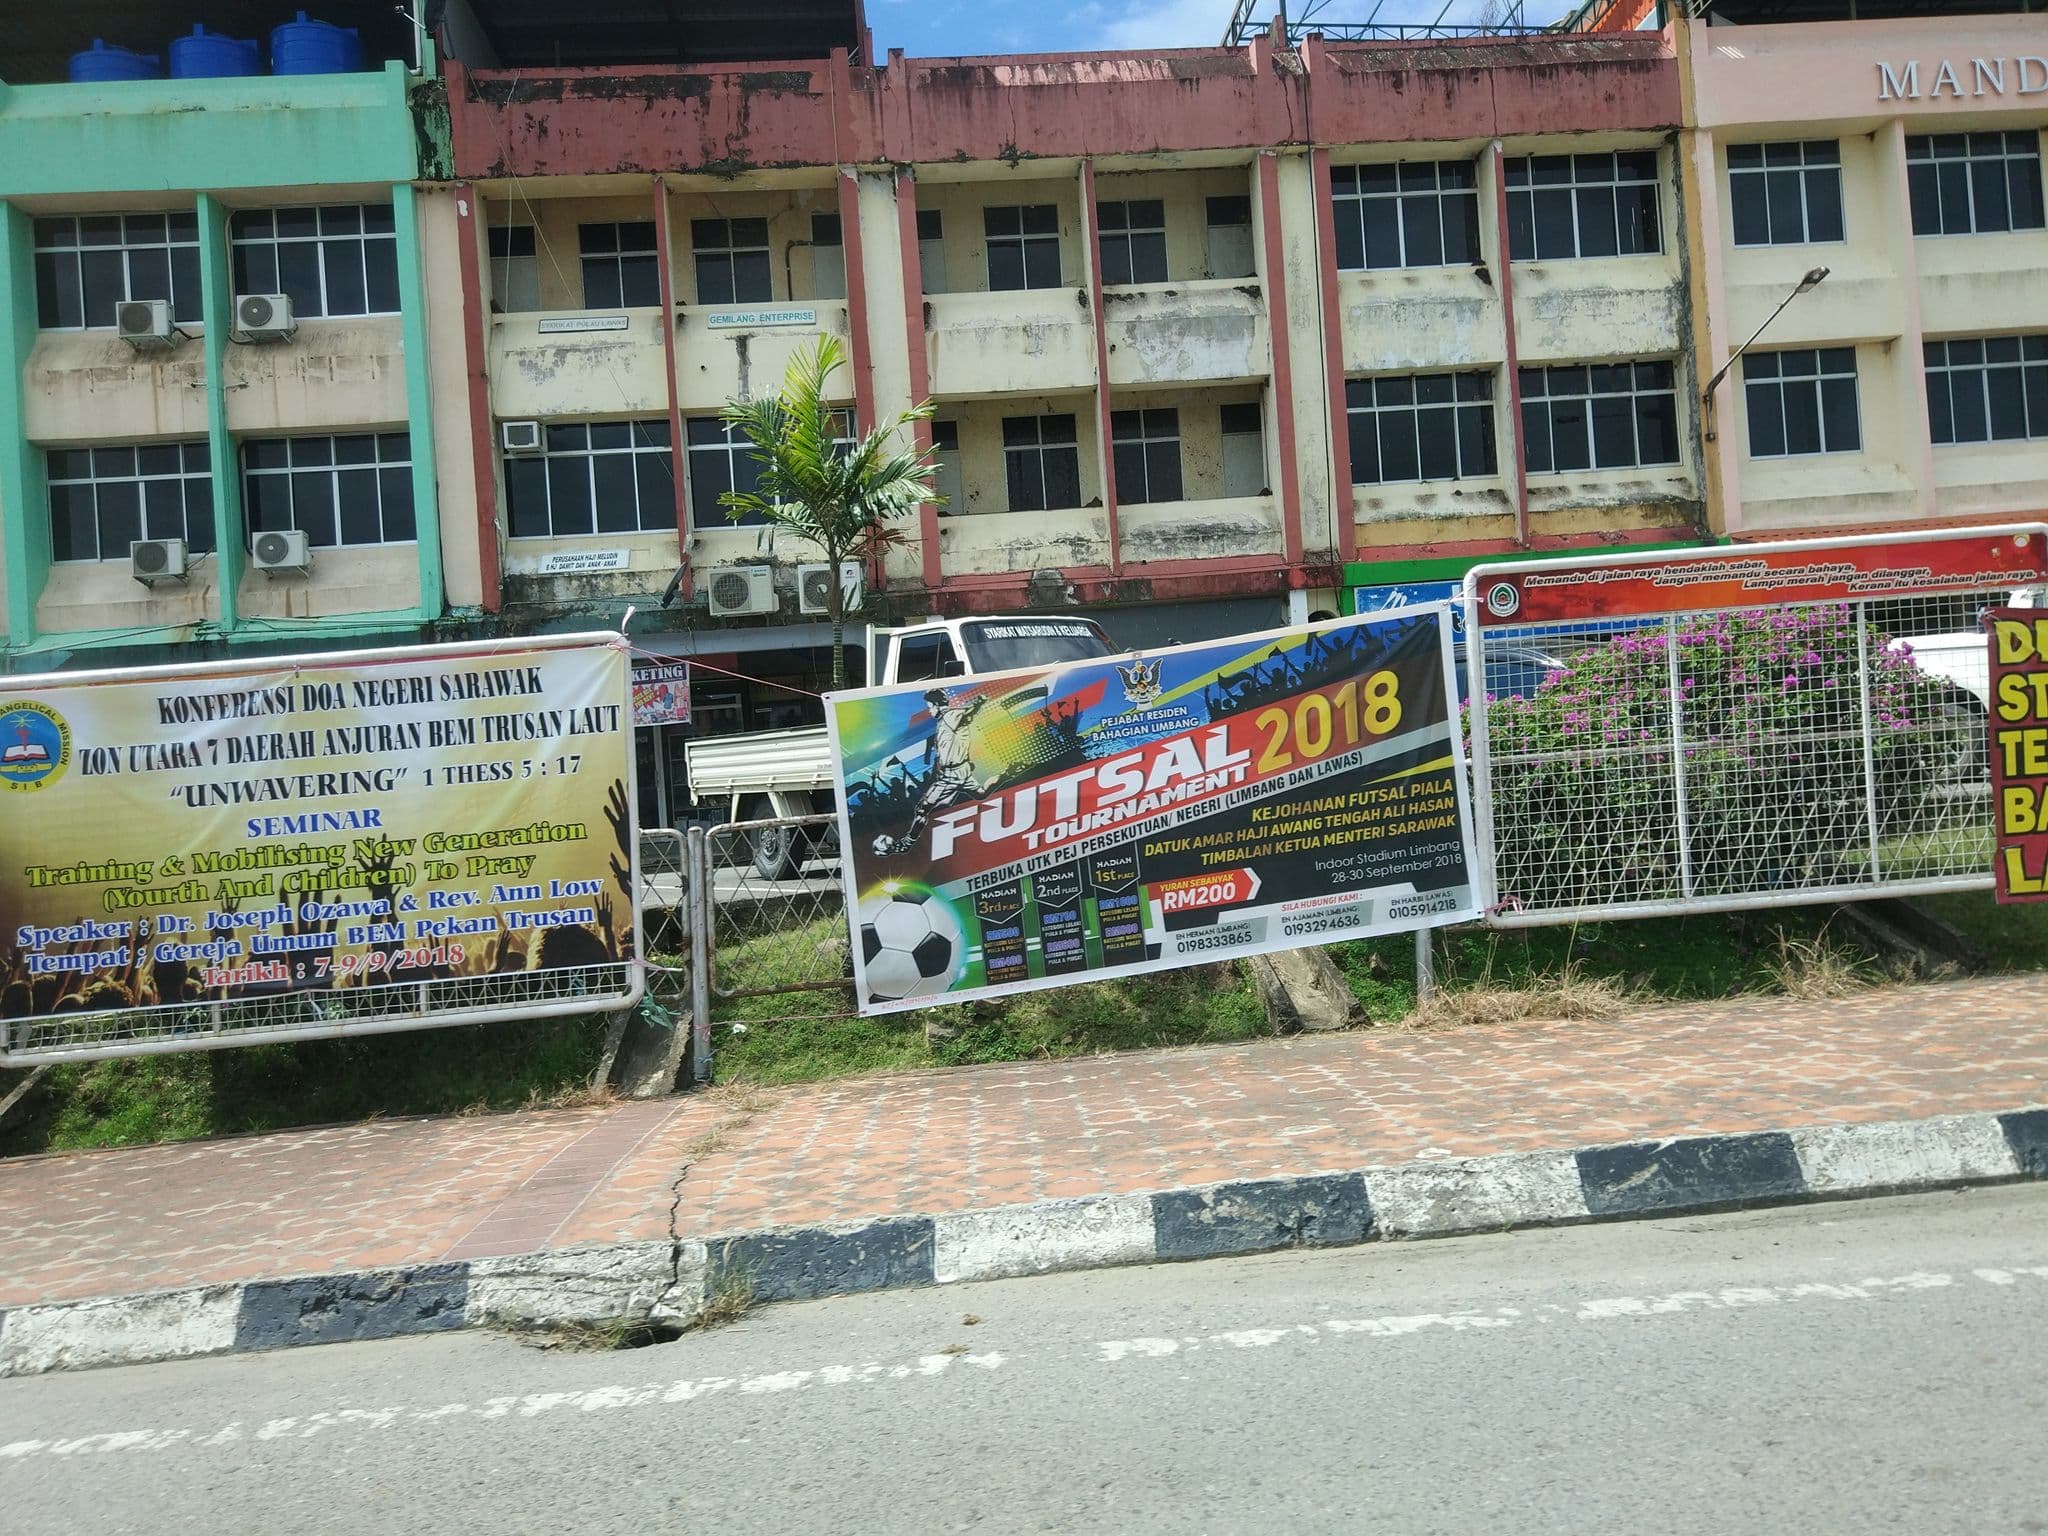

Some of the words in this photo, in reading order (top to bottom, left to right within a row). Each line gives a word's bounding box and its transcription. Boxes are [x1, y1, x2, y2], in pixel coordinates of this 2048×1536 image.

[1876, 55, 2048, 100] MAND
[709, 313, 755, 325] GEMILANG
[759, 311, 814, 322] ENTERPRISE
[1525, 573, 1585, 586] Memandu
[1587, 572, 1599, 581] di
[1601, 571, 1631, 583] jalan
[1634, 569, 1661, 580] raya
[1664, 562, 1726, 575] hendaklah
[1729, 560, 1766, 571] sabar,
[1654, 575, 1698, 586] Jangan
[1702, 569, 1761, 582] memandu
[1764, 567, 1805, 577] secara
[1808, 563, 1855, 574] bahaya,
[1743, 579, 1783, 590] Lampu
[1787, 575, 1825, 585] merah
[1827, 572, 1868, 584] jangan
[1871, 568, 1930, 579] dilanggar,
[1849, 581, 1891, 592] Kerana
[1894, 579, 1909, 587] itu
[1912, 575, 1972, 586] kesalahan
[1974, 572, 2004, 583] jalan
[2007, 570, 2036, 581] raya.
[158, 685, 297, 725] KONFERENSI
[303, 682, 346, 712] DOA
[352, 675, 434, 708] NEGERI
[440, 666, 544, 701] SARAWAK
[1093, 724, 1149, 741] BAHAGIAN
[1151, 717, 1199, 733] LIMBANG
[1101, 713, 1145, 728] PEJABAT
[1147, 706, 1188, 720] RESIDEN
[58, 723, 70, 765] MISSION
[79, 747, 123, 776] ZON
[128, 740, 203, 773] UTARA
[207, 739, 219, 766] 7
[225, 730, 317, 765] DAERAH
[323, 721, 423, 757] ANJURAN
[429, 717, 475, 748] BEM
[481, 709, 563, 743] TRUSAN
[569, 704, 621, 735] LAUT
[423, 768, 434, 787] 1
[443, 761, 513, 785] THESS
[521, 759, 532, 779] 5
[556, 755, 582, 775] 17
[931, 725, 1250, 860] FUTSAL
[1255, 670, 1402, 775] 2018
[1022, 761, 1251, 850] TOURNAMENT
[1252, 794, 1345, 822] KEJOHANAN
[1349, 785, 1408, 808] FUTSAL
[1411, 778, 1453, 797] PIALA
[247, 808, 384, 839] SEMINAR
[966, 864, 1024, 892] TERBUKA
[1027, 855, 1051, 872] UTK
[1055, 847, 1078, 863] PEJ
[1081, 812, 1173, 855] PERSEKUTUAN/
[1177, 800, 1221, 822] NEGERI
[1225, 775, 1285, 809] (LIMBANG
[1289, 769, 1314, 787] DAN
[1318, 751, 1363, 779] LAWAS)
[1145, 838, 1191, 857] DATUK
[1193, 831, 1234, 849] AMAR
[1236, 825, 1268, 842] HAJI
[1270, 817, 1322, 837] AWANG
[1325, 808, 1380, 828] TENGAH
[1383, 804, 1405, 819] ALI
[1408, 796, 1454, 815] HASAN
[25, 859, 154, 888] Training
[161, 856, 185, 877] &
[192, 842, 346, 874] Mobilising
[354, 837, 416, 860] New
[423, 821, 588, 853] Generation
[1200, 843, 1272, 866] TIMBALAN
[1275, 835, 1321, 854] KETUA
[1323, 825, 1385, 846] MENTERI
[1388, 815, 1456, 836] SARAWAK
[1097, 857, 1132, 868] HADIAH
[1315, 856, 1354, 871] Indoor
[1357, 848, 1407, 865] Stadium
[1410, 840, 1460, 856] Limbang
[1332, 869, 1364, 883] 28-30
[1366, 860, 1433, 878] September
[1435, 853, 1462, 867] 2018
[103, 879, 208, 913] (Yourth
[215, 874, 274, 900] And
[283, 864, 416, 892] Children)
[424, 858, 459, 882] To
[467, 853, 536, 880] Pray
[1038, 872, 1074, 883] HADIAH
[1096, 869, 1117, 883] 1st
[1160, 879, 1189, 892] YURAN
[1191, 873, 1234, 887] SEBANYAK
[981, 888, 1017, 899] HADIAH
[1037, 885, 1060, 898] 2nd
[1163, 882, 1236, 911] RM200
[1281, 902, 1299, 912] SILA
[1300, 897, 1337, 909] HUBUNGI
[1338, 893, 1359, 903] KAMI
[16, 919, 132, 949] Speaker
[156, 915, 197, 935] Dr.
[203, 903, 294, 931] Joseph
[301, 898, 391, 921] Ozawa
[400, 893, 418, 913] &
[428, 890, 481, 910] Rev.
[489, 884, 541, 905] Ann
[549, 878, 603, 899] Low
[979, 901, 1000, 914] 3rd
[1389, 899, 1457, 919] 0105914218
[1284, 914, 1360, 936] 0193294636
[24, 945, 130, 974] Tempat
[153, 939, 243, 964] Gereja
[251, 931, 337, 955] Umum
[347, 921, 408, 946] BEM
[416, 915, 497, 939] Pekan
[505, 906, 595, 931] Trusan
[1177, 931, 1252, 953] 0198333865
[202, 960, 289, 988] Tarikh
[313, 943, 466, 979] 7-9/9/2018
